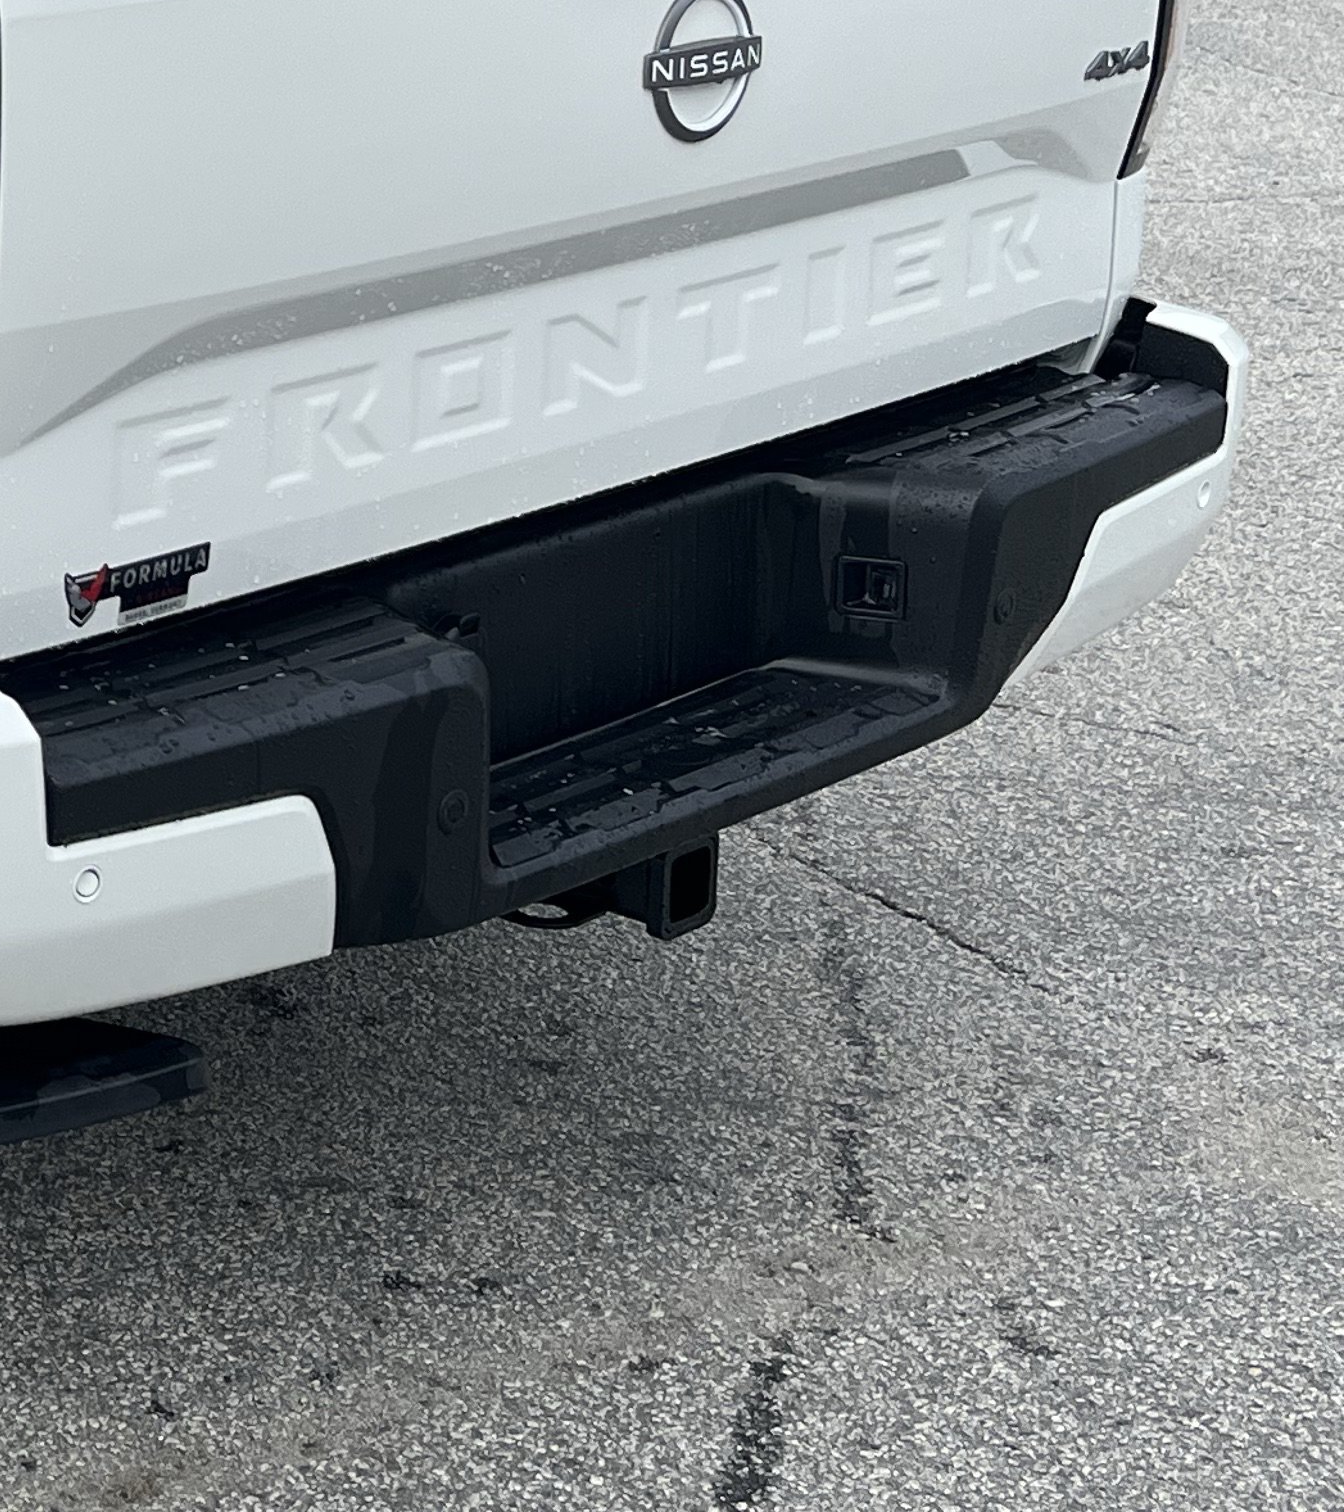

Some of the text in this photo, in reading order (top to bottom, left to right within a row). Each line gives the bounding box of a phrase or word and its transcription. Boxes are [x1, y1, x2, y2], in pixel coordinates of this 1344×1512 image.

[651, 44, 761, 82] NISSAN
[112, 192, 1041, 531] FRONTIER
[110, 548, 207, 592] FORMULA
